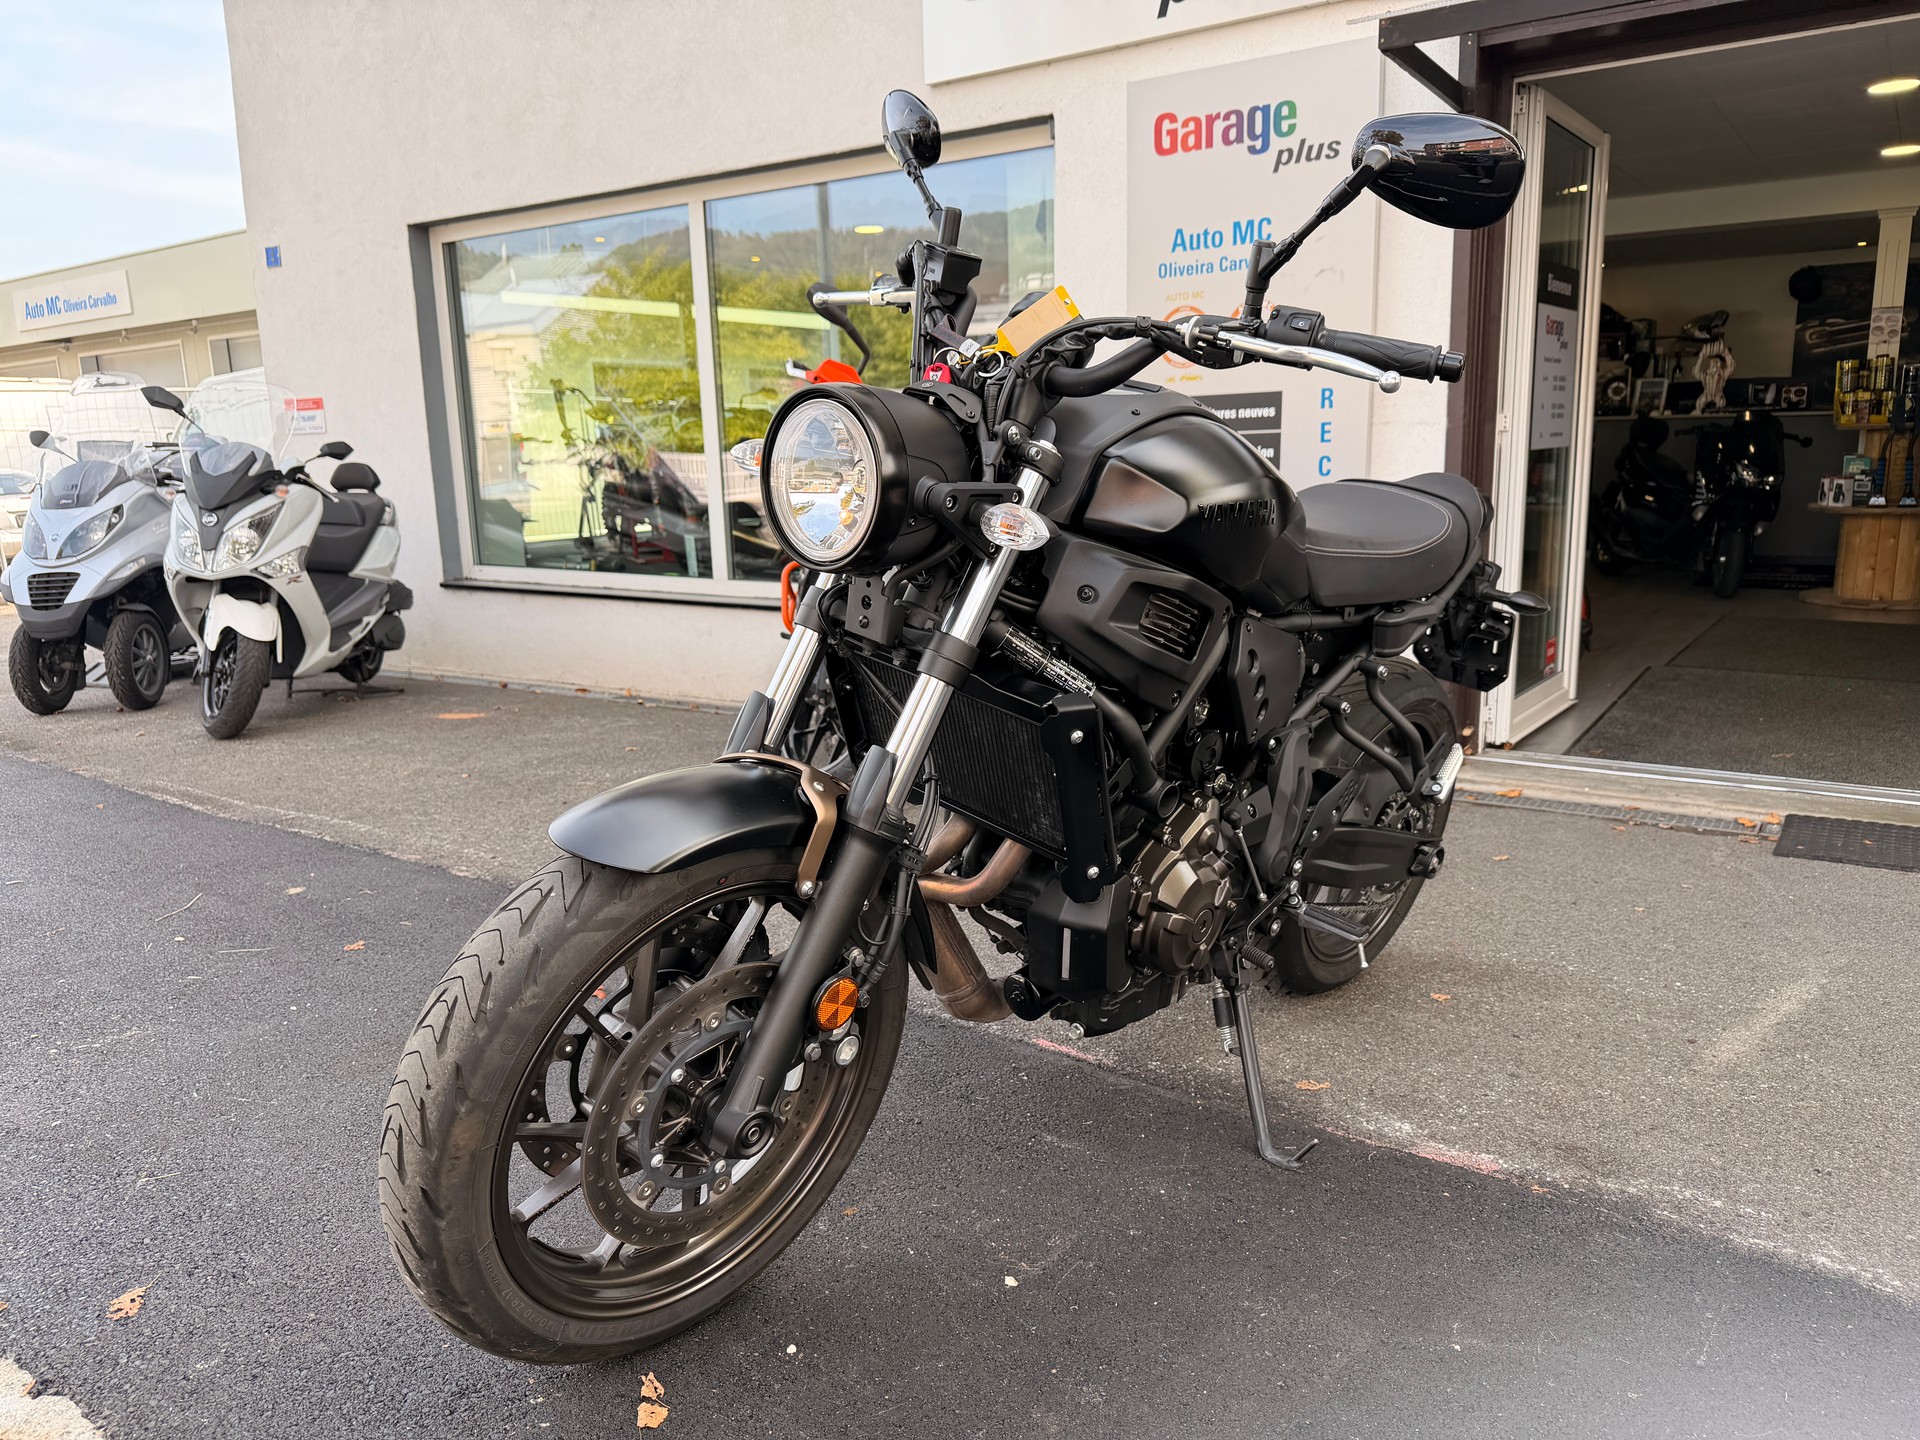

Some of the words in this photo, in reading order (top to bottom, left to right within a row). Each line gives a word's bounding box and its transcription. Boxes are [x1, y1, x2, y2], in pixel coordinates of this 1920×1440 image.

[1153, 99, 1298, 157] Garage
[1272, 137, 1342, 174] plus
[1170, 227, 1224, 253] Auto
[1232, 216, 1273, 246] MC
[1158, 259, 1214, 279] Oliveira
[24, 301, 45, 320] Auto
[45, 295, 62, 316] MC
[62, 297, 88, 313] Oliveira
[87, 291, 118, 309] Carvalho
[1165, 291, 1190, 303] AUTO
[1191, 289, 1206, 300] MC
[1545, 314, 1565, 342] Garage
[1238, 406, 1277, 419] neuves
[1197, 498, 1277, 532] YAMAHA
[501, 1287, 513, 1300] 17
[511, 1297, 525, 1313] ZR
[523, 1308, 557, 1332] 120/70
